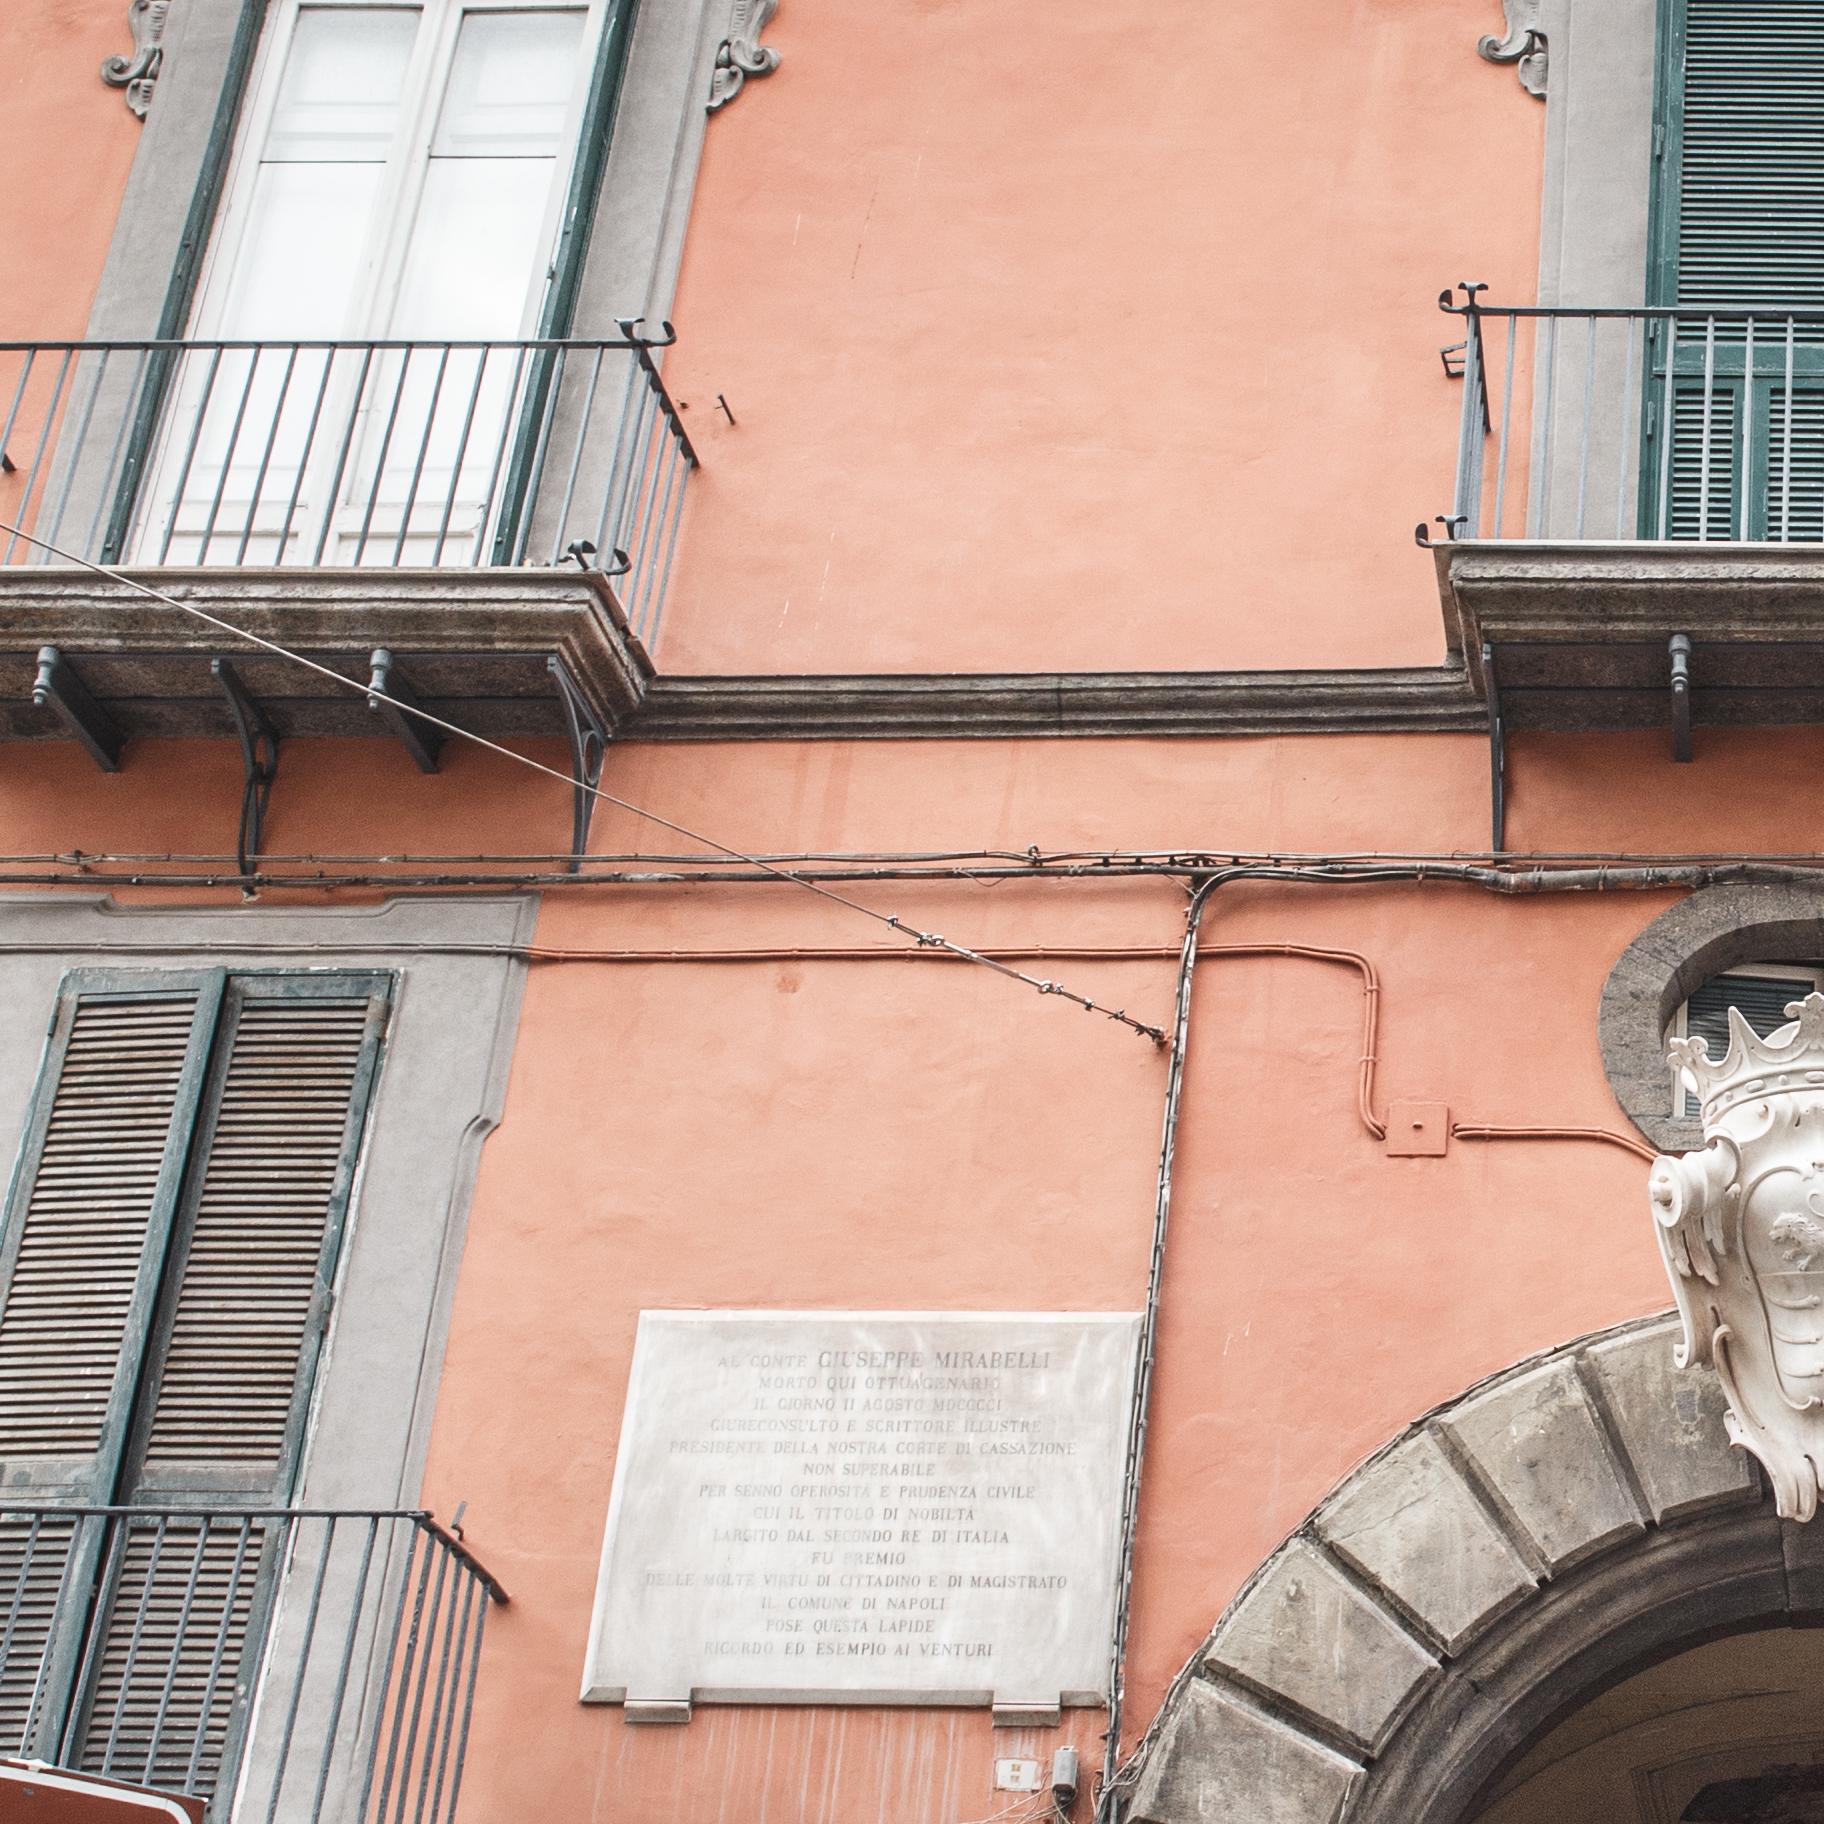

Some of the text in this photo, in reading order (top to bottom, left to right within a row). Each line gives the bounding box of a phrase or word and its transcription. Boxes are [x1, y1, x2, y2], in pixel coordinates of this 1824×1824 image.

[750, 1355, 807, 1368] CONTE
[818, 1351, 923, 1369] GIUSEPPE
[936, 1352, 1050, 1369] MIRABELLI
[759, 1377, 1000, 1391] MORTO QUI OTTUAGENARIO
[754, 1398, 768, 1411] IL
[778, 1398, 835, 1411] GIORNO
[863, 1398, 924, 1411] AGOSTO
[711, 1419, 1041, 1433] GIURECONSULTO E SCRITTORE ILLUSTRE
[669, 1441, 1076, 1456] PRESIDENTE DELLA NOSTRA CORTE DI CASSAZIONE
[803, 1463, 936, 1477] NON SUPERABILE
[700, 1484, 726, 1497] PER
[735, 1484, 783, 1497] SENNO
[880, 1486, 890, 1498] E
[900, 1486, 976, 1499] PRUDENZA
[987, 1486, 1035, 1499] CIVILE
[753, 1507, 780, 1520] CUI
[789, 1507, 805, 1520] IL
[815, 1507, 874, 1520] TITOLO
[883, 1508, 898, 1521] DI
[713, 1529, 1009, 1544] LARGITO DAL SECONDO RE DI ITALIA
[811, 1551, 906, 1565] FU PREMIO
[646, 1573, 695, 1586] DELLE
[703, 1573, 754, 1587] MOLTE
[817, 1574, 831, 1587] DI
[840, 1575, 921, 1588] CITTADINO
[928, 1575, 937, 1588] E
[947, 1575, 962, 1588] DI
[970, 1575, 1067, 1589] MAGISTRATO
[761, 1596, 945, 1610] IL COMUNE DI NAPOLI
[766, 1619, 936, 1634] POSE QUESTA LAPIDE
[704, 1641, 992, 1657] RICORDO ED ESEMPIO AI VENTURI
